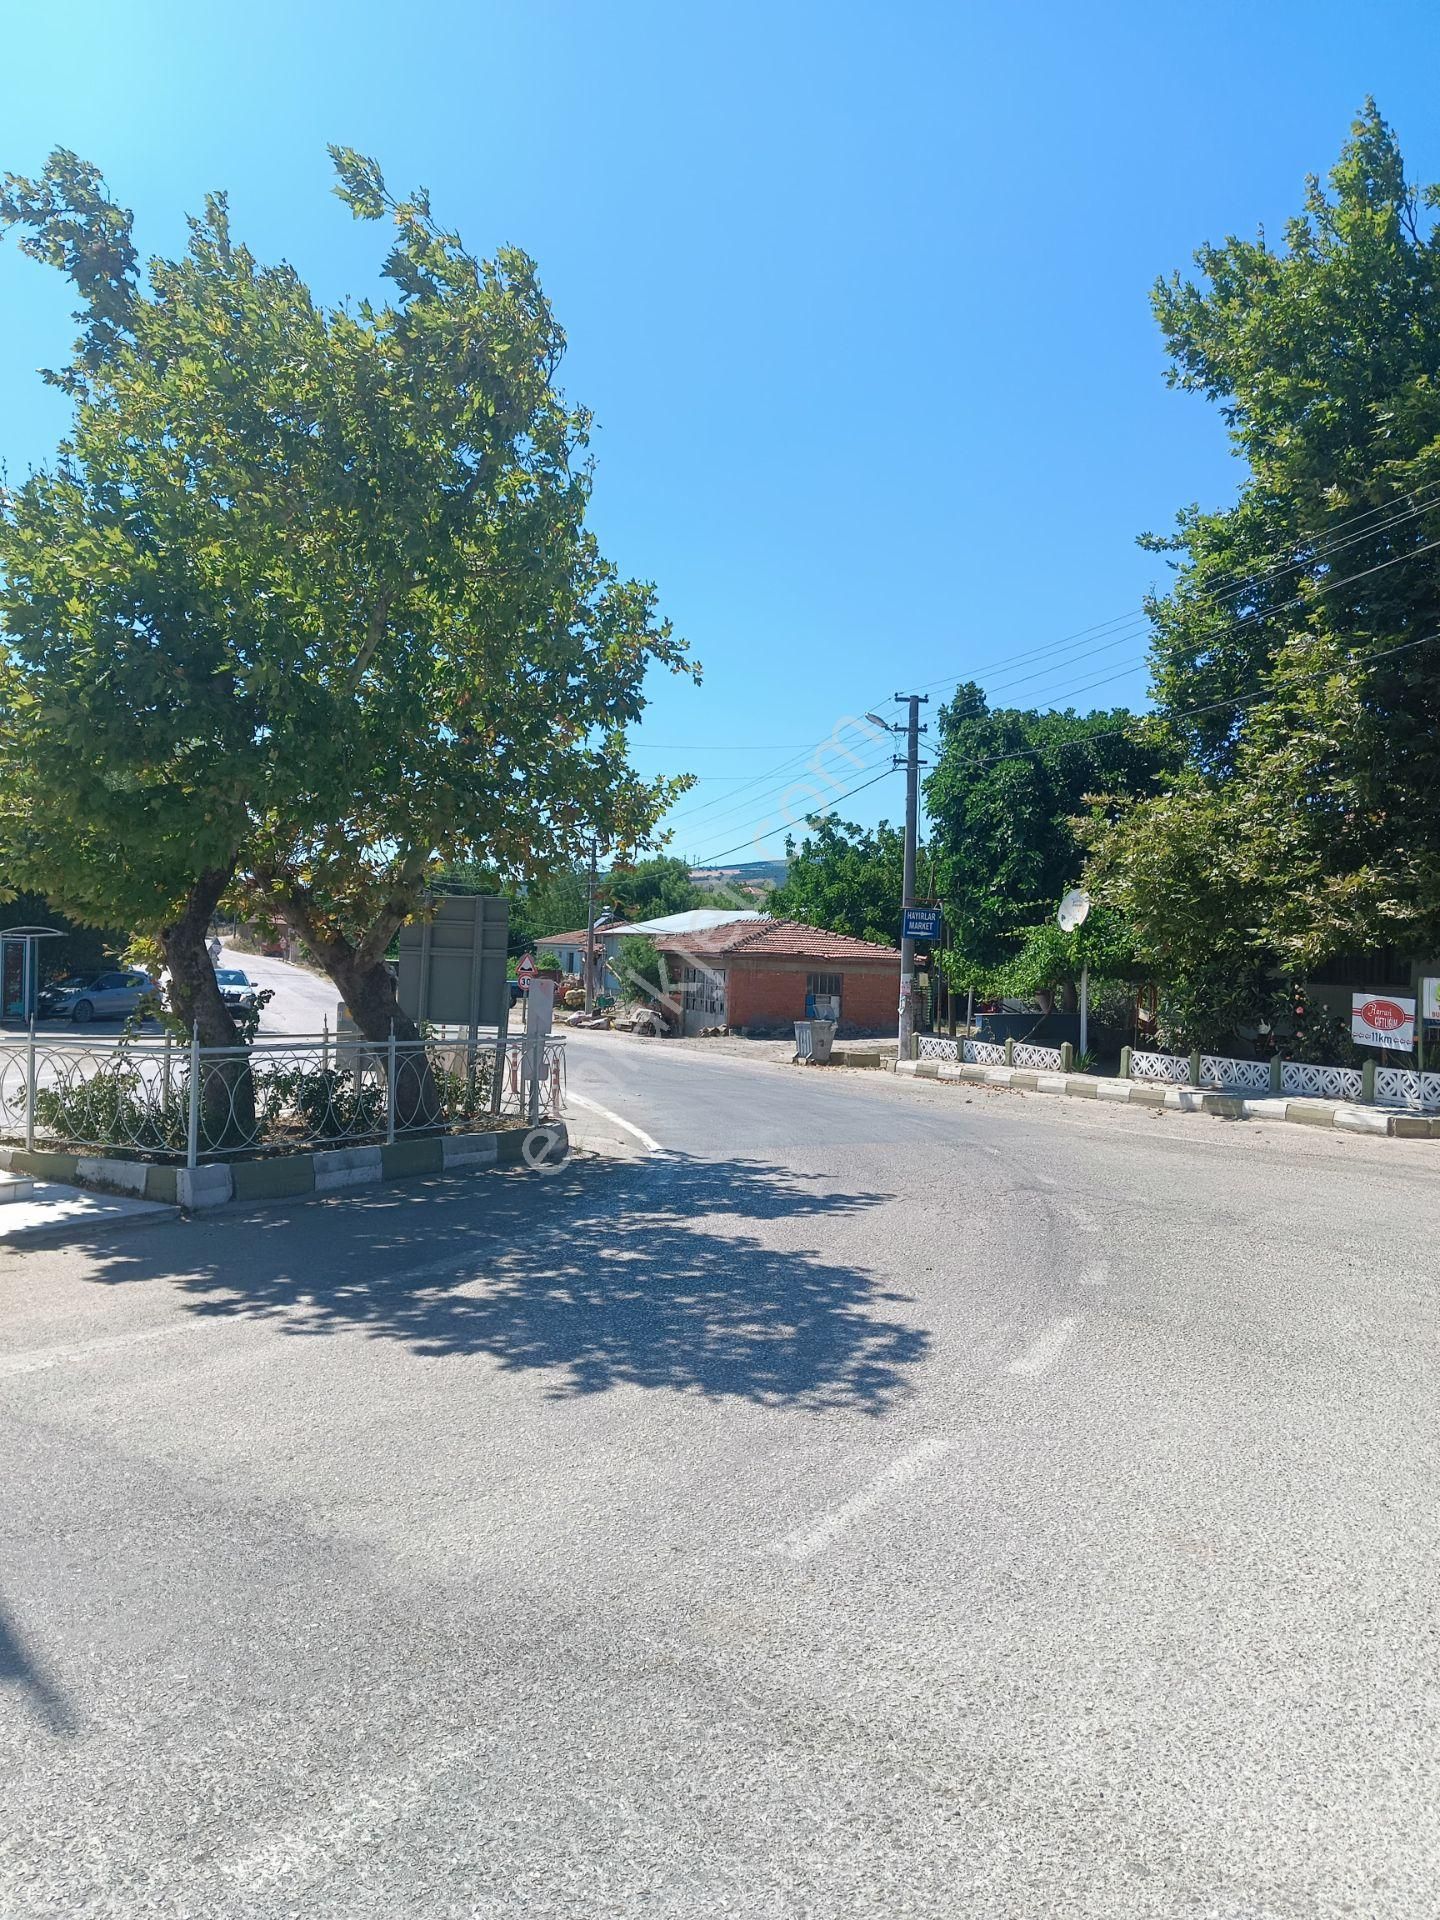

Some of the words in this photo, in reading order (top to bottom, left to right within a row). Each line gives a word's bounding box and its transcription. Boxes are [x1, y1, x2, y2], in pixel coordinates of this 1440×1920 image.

[907, 912, 935, 920] HAYIRLAR
[909, 922, 933, 931] MARKET
[1371, 1032, 1392, 1043] 11km
